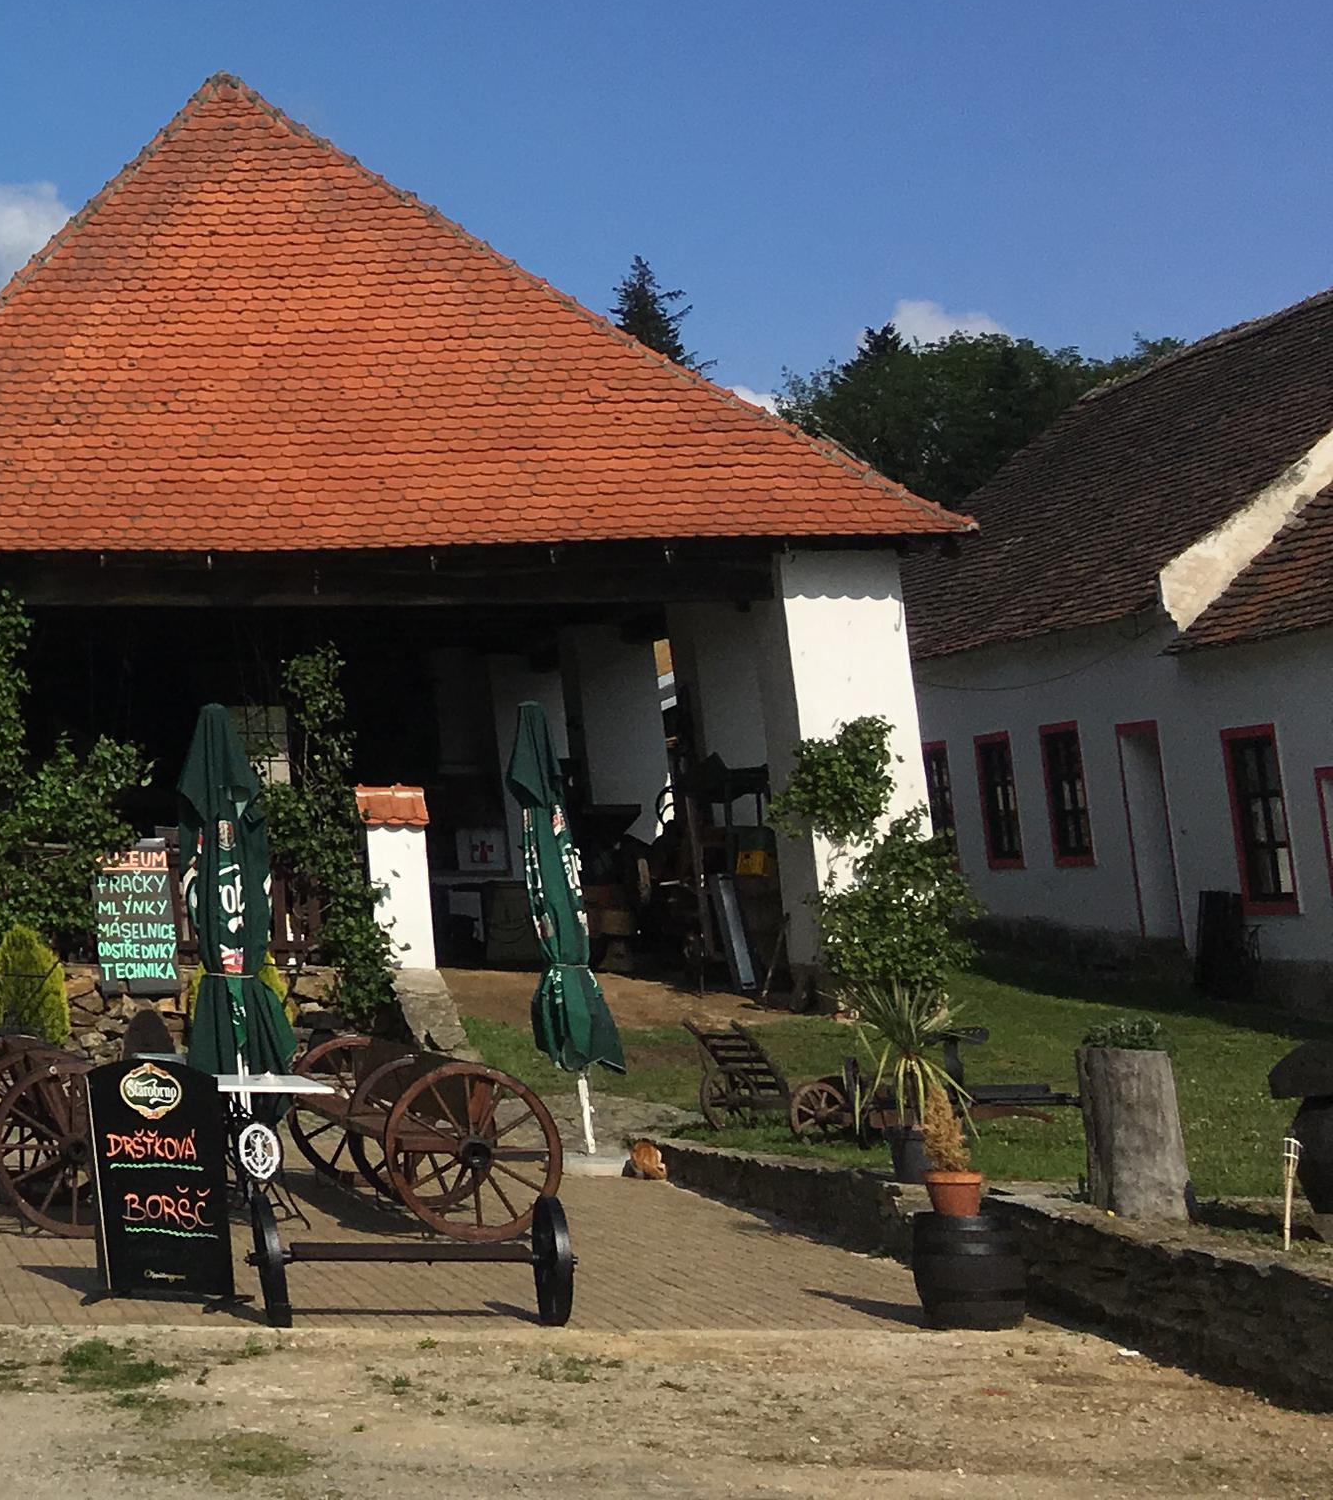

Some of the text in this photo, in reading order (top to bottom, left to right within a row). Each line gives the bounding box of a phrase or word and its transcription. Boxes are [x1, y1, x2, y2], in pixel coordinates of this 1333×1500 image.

[97, 894, 168, 916] MLÝNKY
[97, 916, 177, 940] MÁSELNICE
[100, 962, 178, 981] TECHNIKA
[124, 1078, 177, 1105] Starobrno
[121, 1184, 215, 1231] BORŠČ
